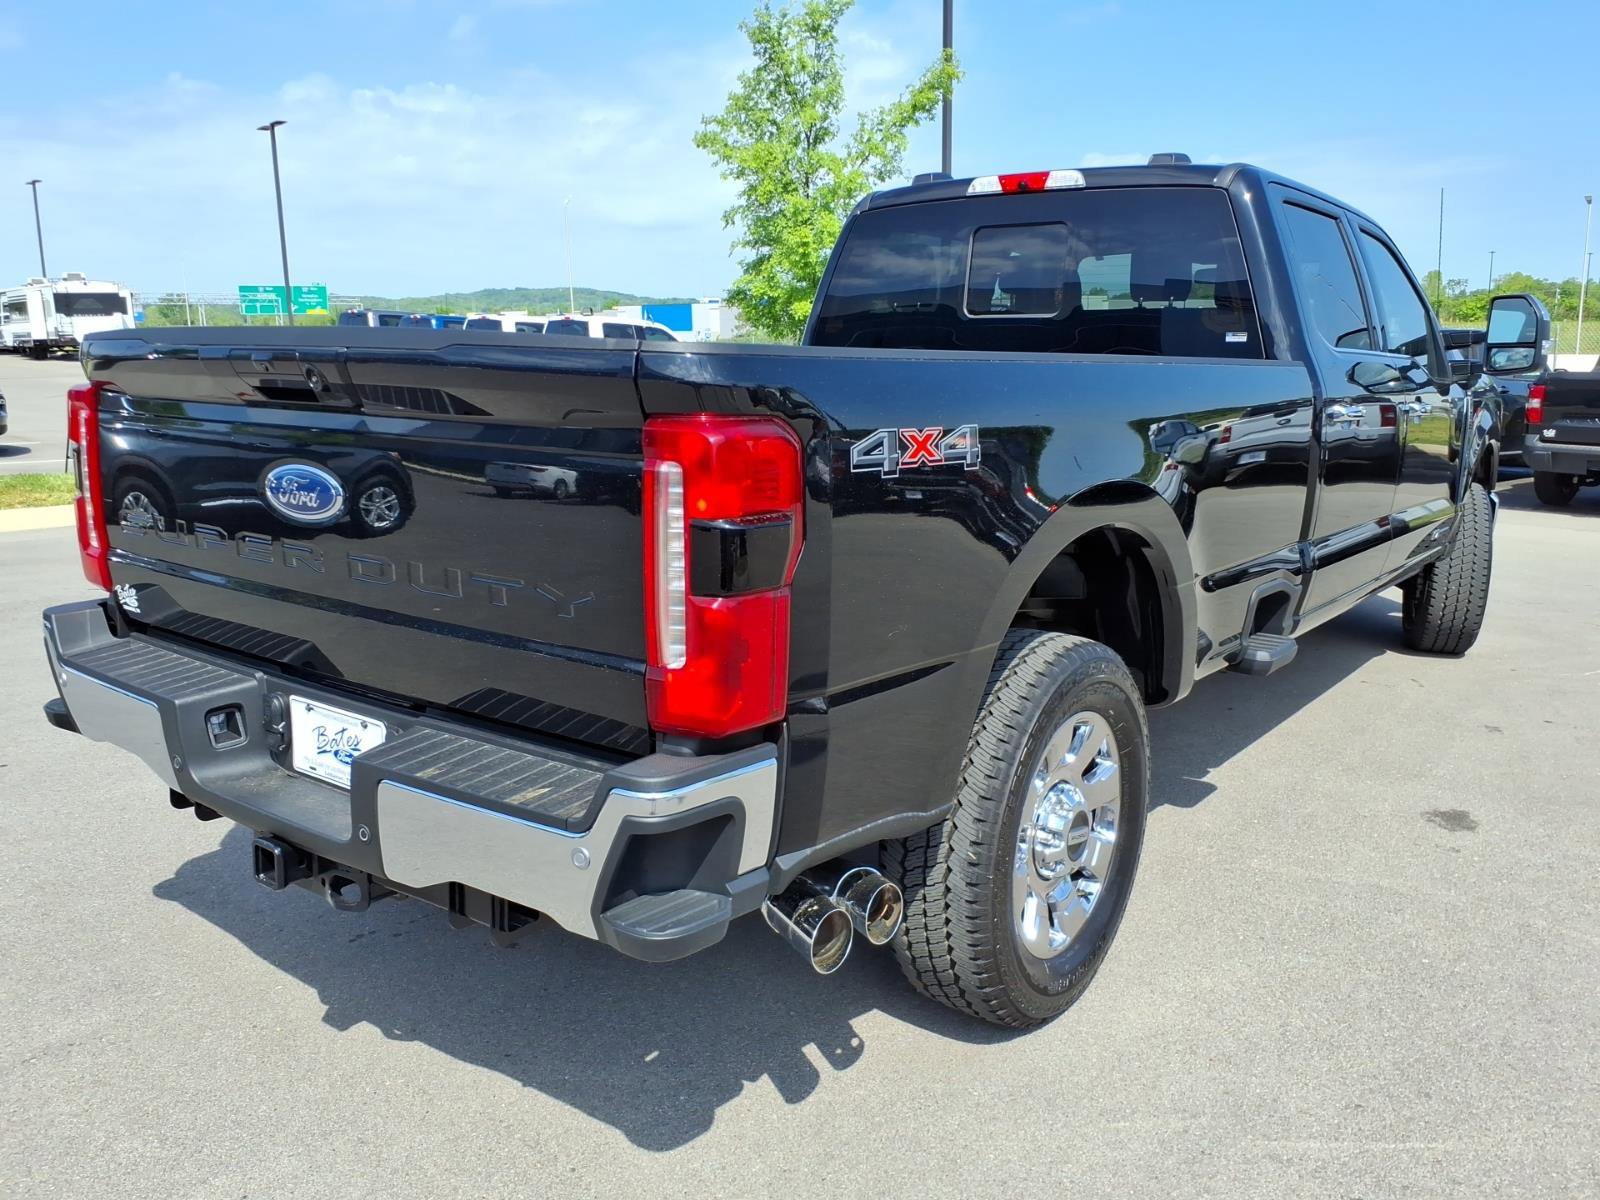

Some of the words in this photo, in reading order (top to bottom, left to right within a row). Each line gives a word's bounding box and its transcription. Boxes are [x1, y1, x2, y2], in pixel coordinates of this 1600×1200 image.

[278, 475, 320, 507] Ford
[118, 507, 326, 573] SUPER
[347, 552, 596, 618] DUTY
[312, 725, 362, 750] Bates
